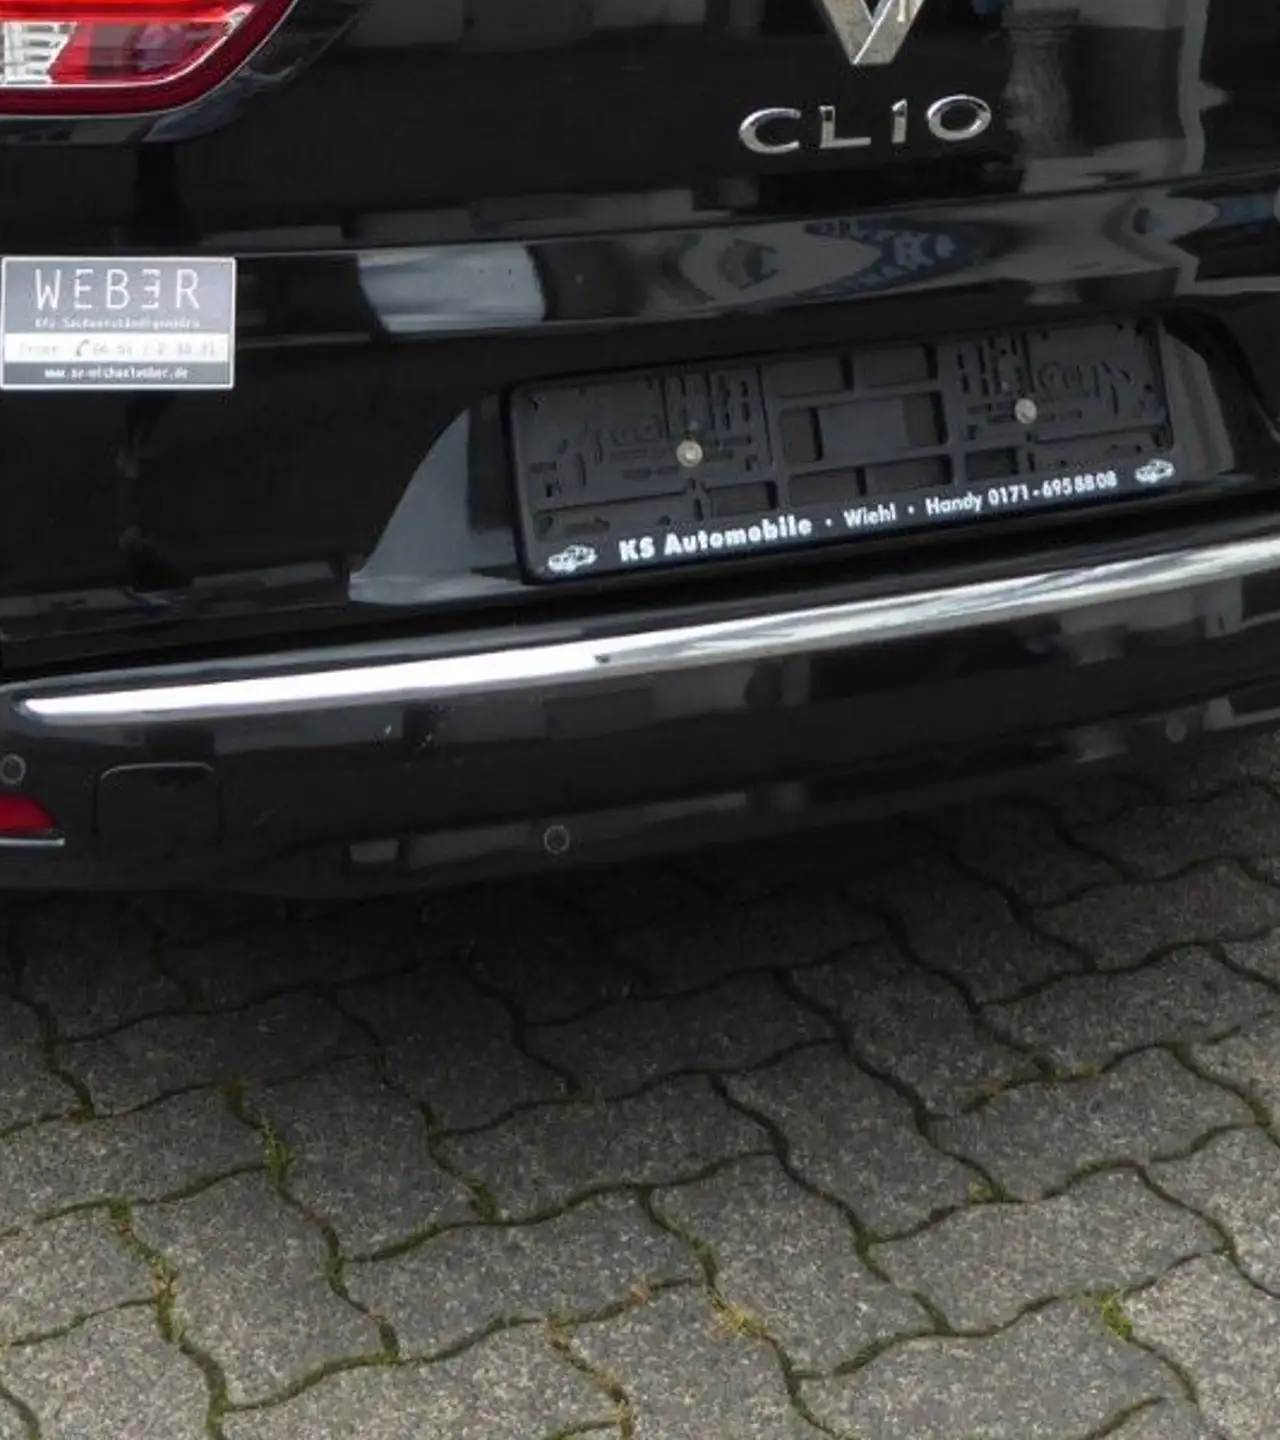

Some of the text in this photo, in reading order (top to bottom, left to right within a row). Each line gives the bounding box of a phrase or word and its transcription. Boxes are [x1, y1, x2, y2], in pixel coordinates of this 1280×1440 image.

[618, 535, 656, 562] KS
[664, 514, 813, 557] Automobile
[844, 502, 897, 529] Wiehl
[924, 491, 983, 516] Handy
